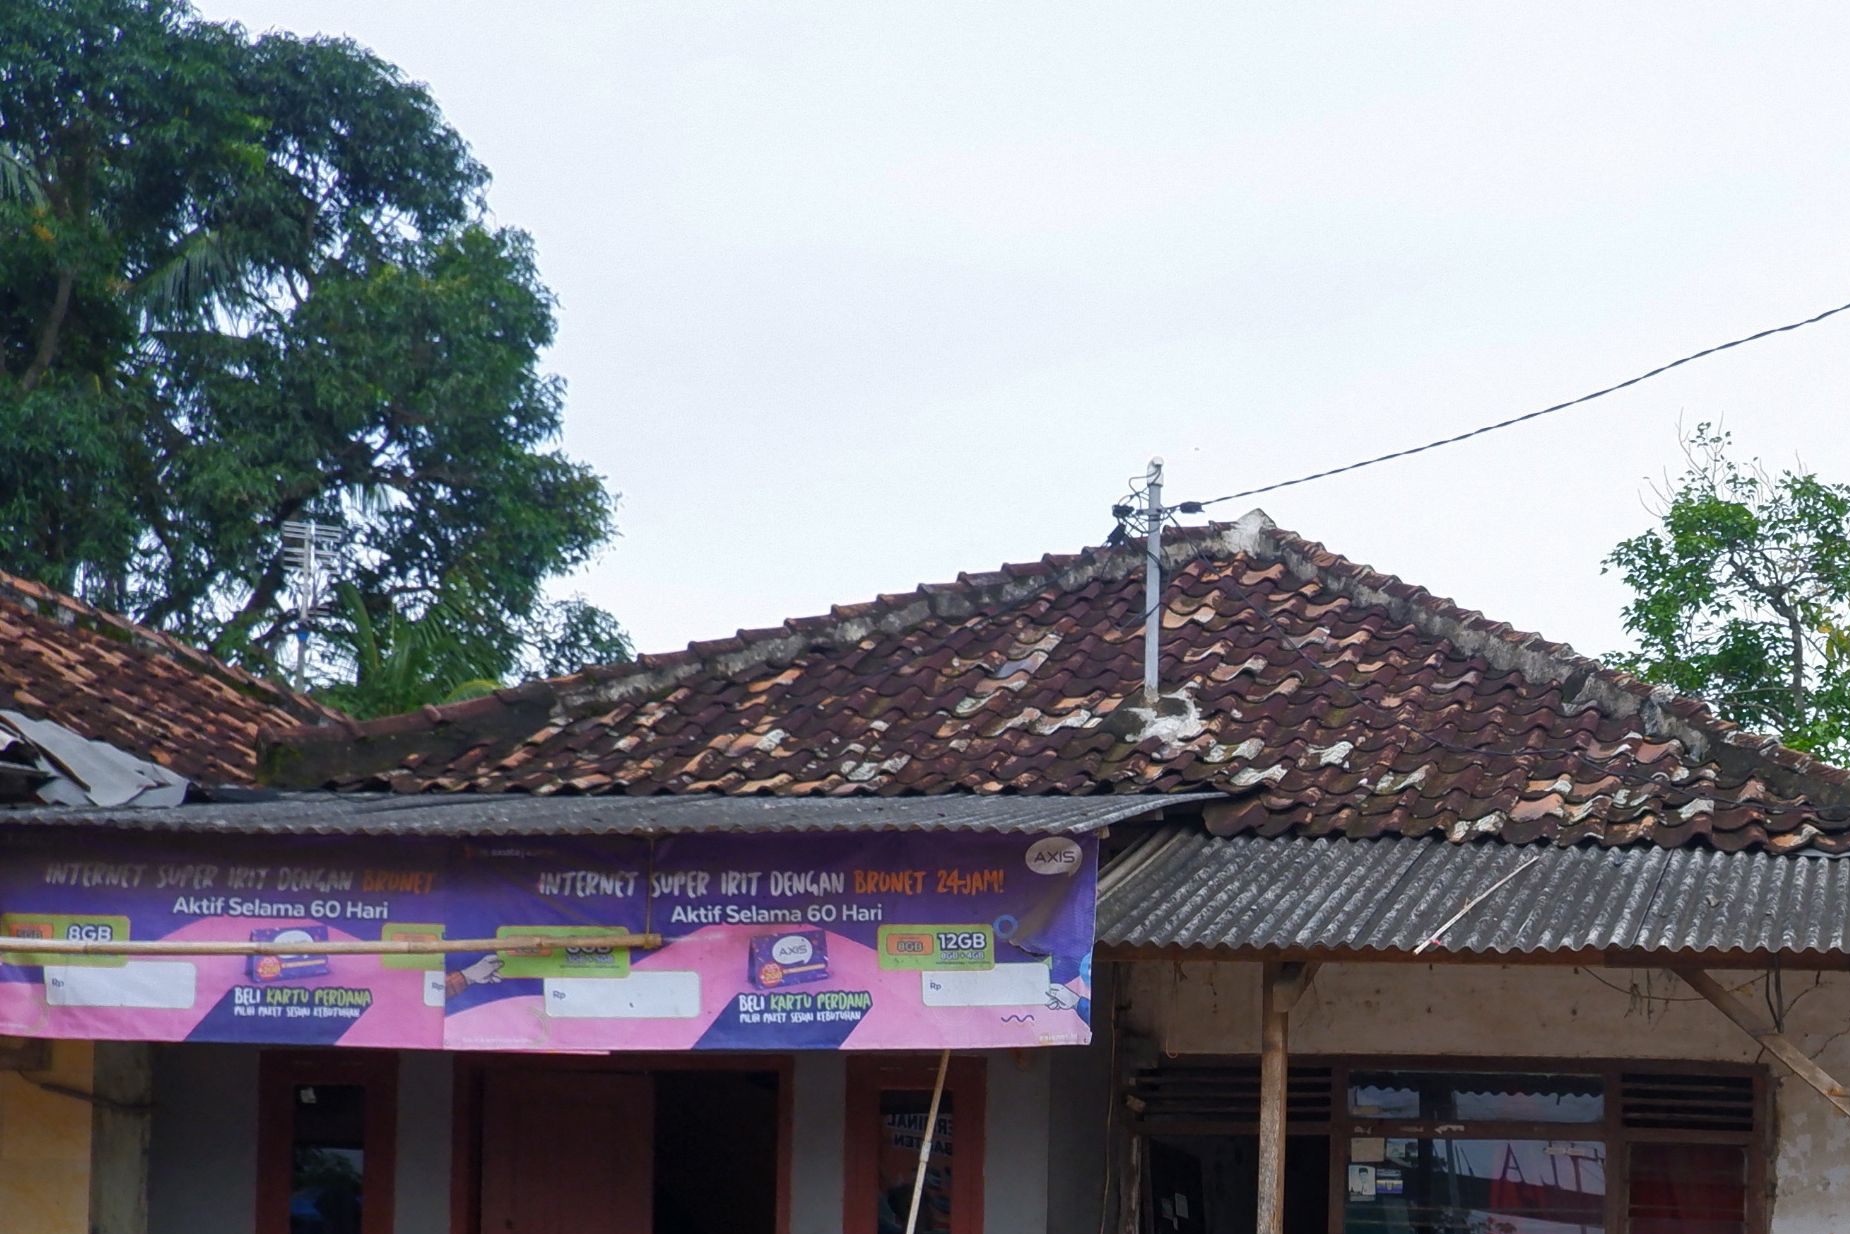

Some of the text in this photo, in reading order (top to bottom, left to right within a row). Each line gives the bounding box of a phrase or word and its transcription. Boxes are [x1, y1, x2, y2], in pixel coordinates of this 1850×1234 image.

[1033, 850, 1076, 864] AXIS
[45, 862, 147, 888] INTERNET
[157, 864, 218, 890] SUPER
[228, 866, 270, 890] IRIT
[277, 867, 353, 893] DENGAN
[538, 870, 639, 898] INTERNET
[651, 871, 710, 899] SUPER
[721, 870, 762, 896] IRIT
[770, 870, 844, 897] DENGAN
[173, 896, 388, 919] Aktif Selama 60 Hari
[671, 903, 883, 924] Aktif Selama 60 Hari
[67, 924, 113, 941] 8GB
[938, 932, 986, 950] 12GB
[779, 944, 809, 957] AXIS
[51, 978, 65, 988] Rp
[929, 982, 942, 991] Rp
[234, 986, 372, 1007] BELI KARTU PERDANA
[552, 990, 567, 1001] Rp
[739, 992, 872, 1012] BELI KARTU PERDANA
[763, 1012, 788, 1024] PAKET
